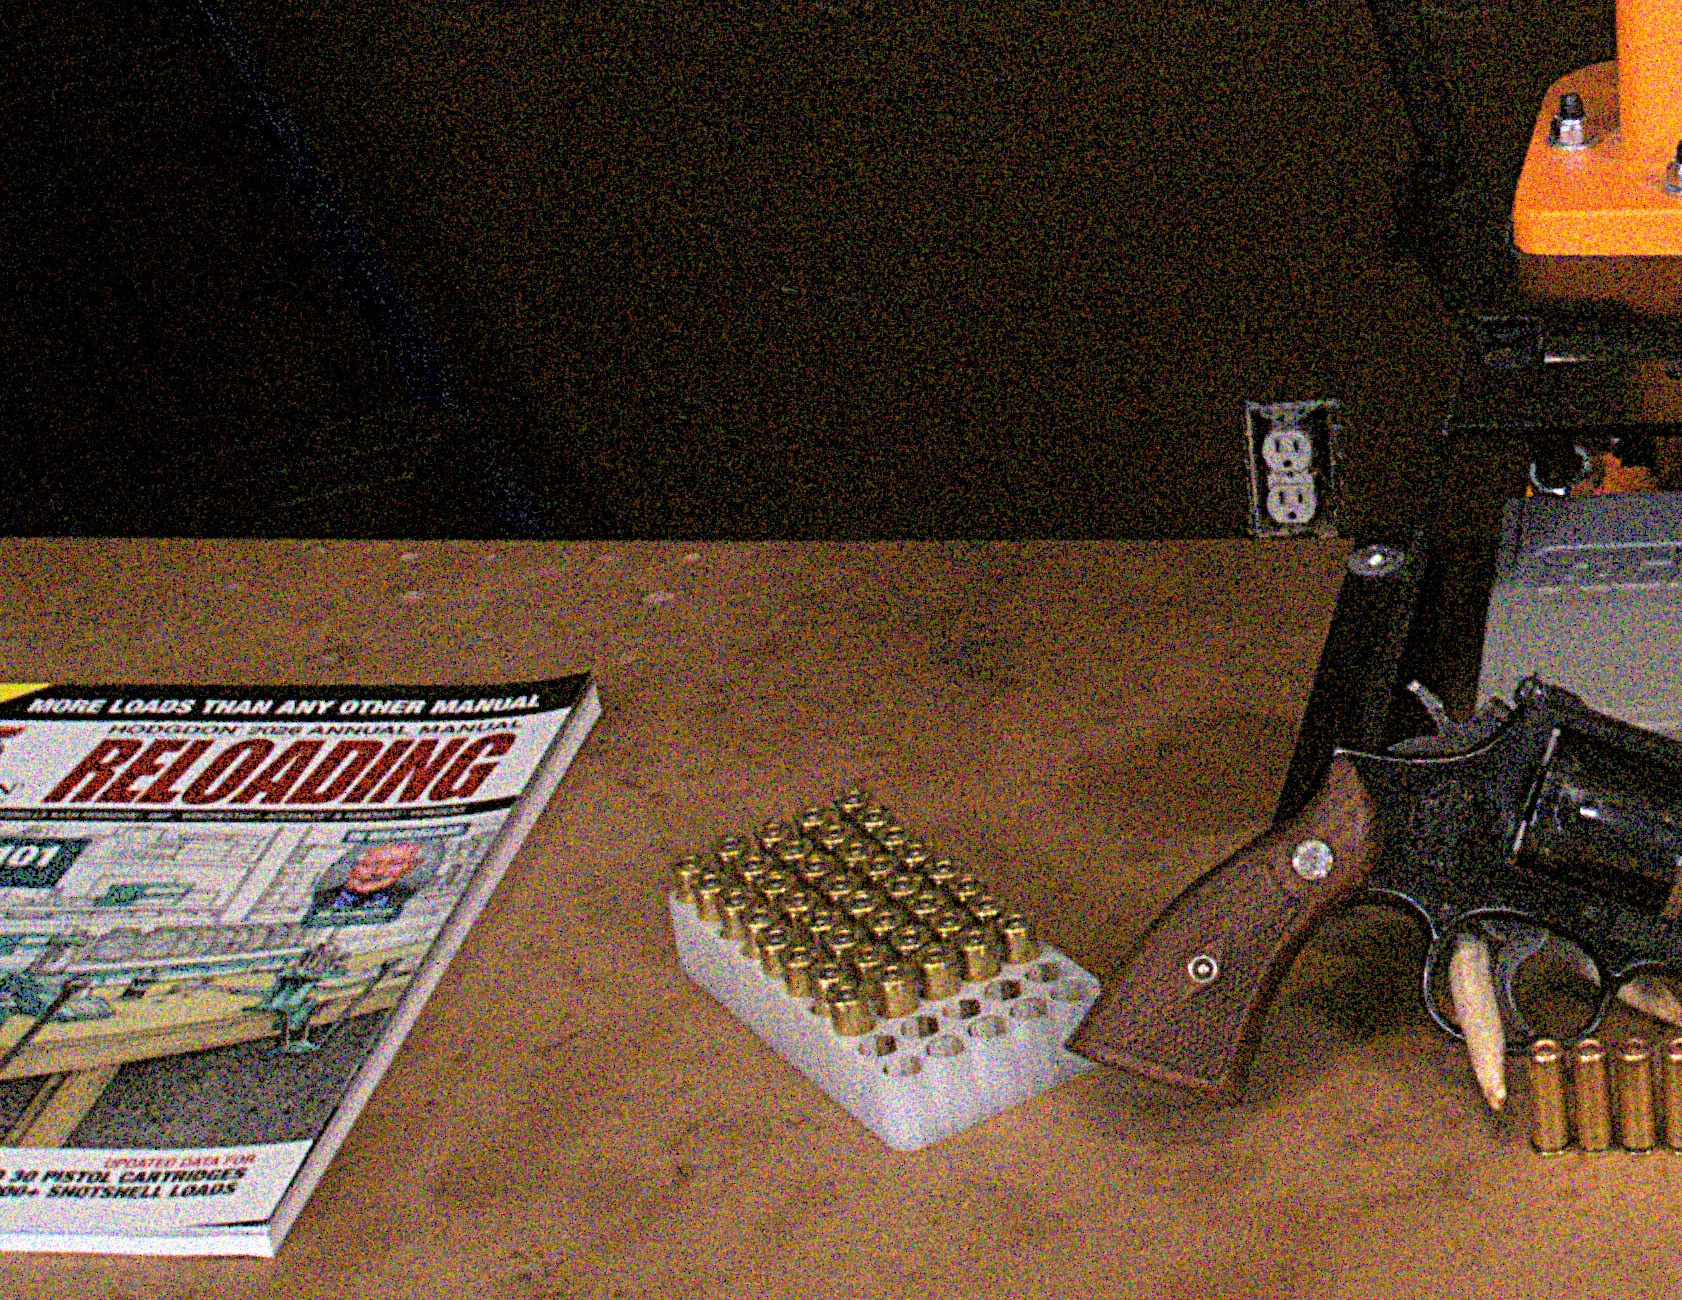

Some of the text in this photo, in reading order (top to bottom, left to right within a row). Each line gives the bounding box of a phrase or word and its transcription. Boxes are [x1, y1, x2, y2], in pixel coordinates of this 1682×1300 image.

[27, 693, 540, 714] MORE LOADS THAN ANY OTHER MANUAL
[108, 724, 240, 736] HODGDON
[305, 724, 409, 736] ANNUAL
[418, 718, 522, 734] MANUAL
[41, 732, 517, 804] RELOADING
[103, 1153, 256, 1168] UPDATED DATA FOR
[9, 1167, 249, 1183] 30 PISTOL CARTRIDGES
[46, 1185, 163, 1199] SHOTSHELL
[168, 1182, 238, 1197] LOADS
